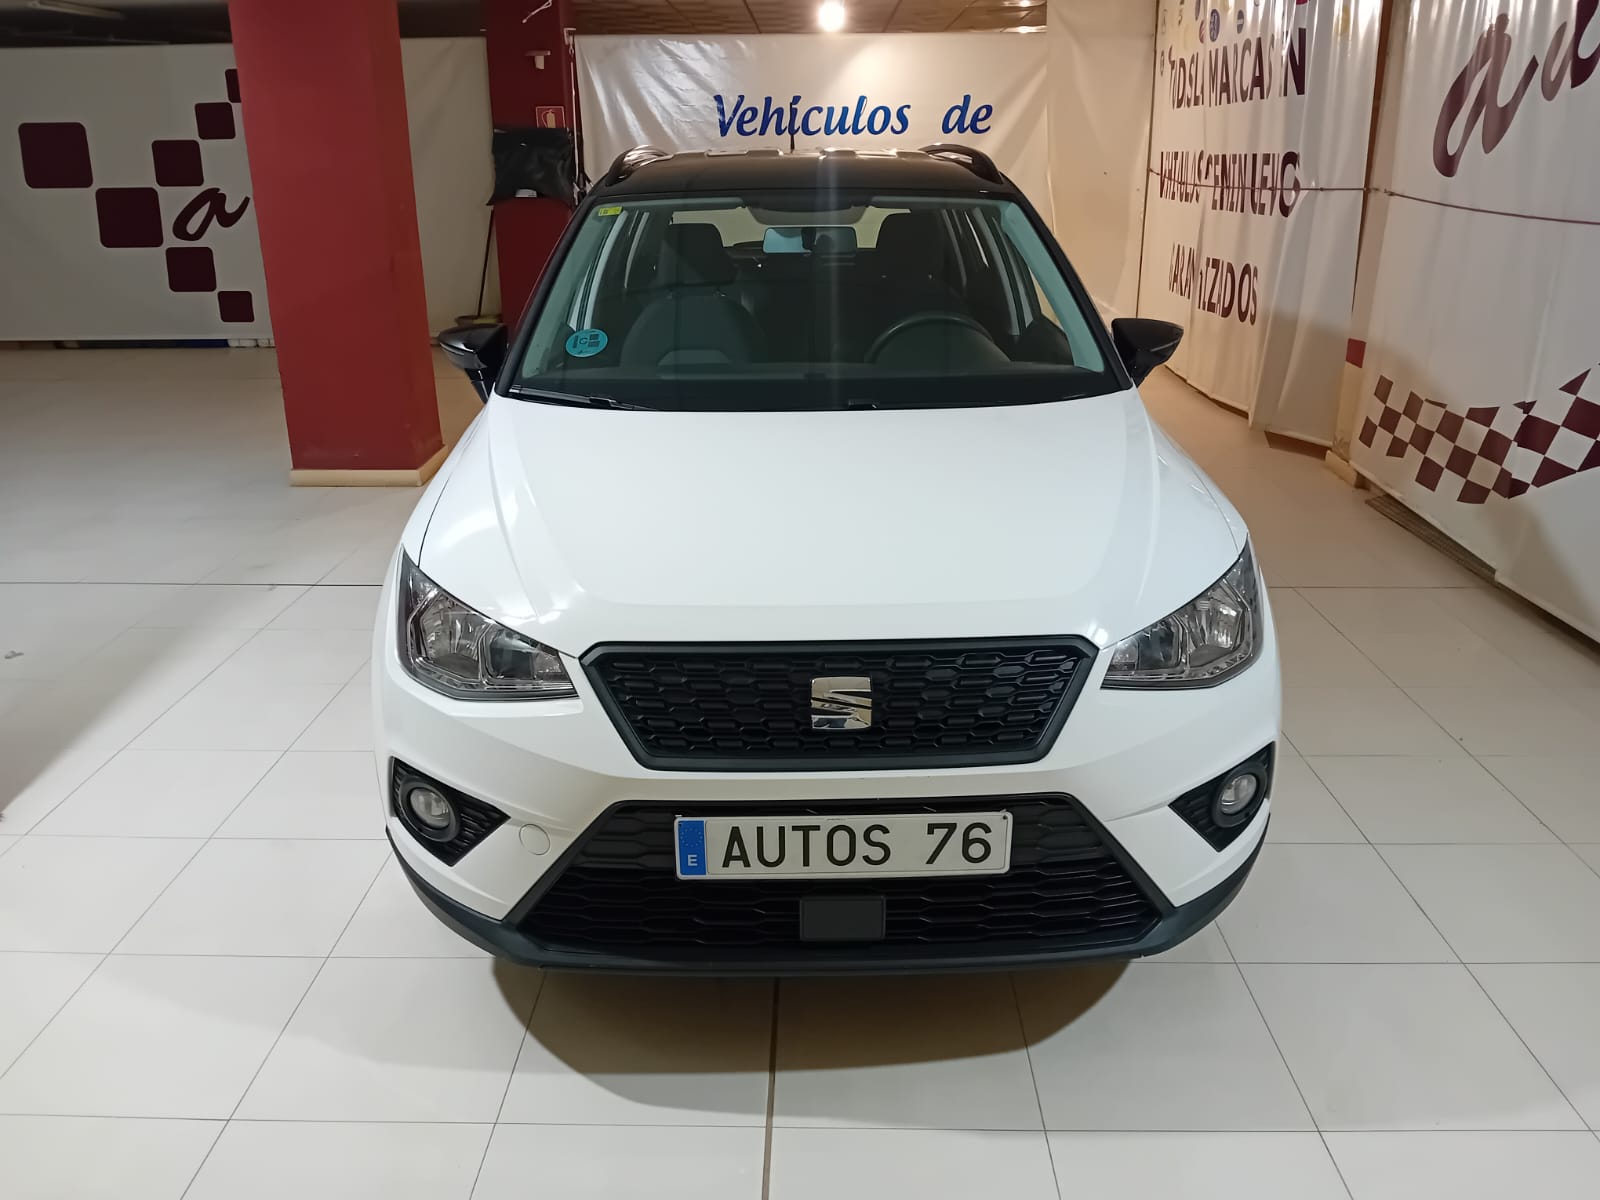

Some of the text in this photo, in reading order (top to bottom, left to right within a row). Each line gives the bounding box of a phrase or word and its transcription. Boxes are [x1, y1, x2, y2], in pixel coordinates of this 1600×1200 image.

[713, 95, 993, 137] Vehículos de
[686, 854, 699, 867] E
[721, 822, 993, 868] AUTOS 76
